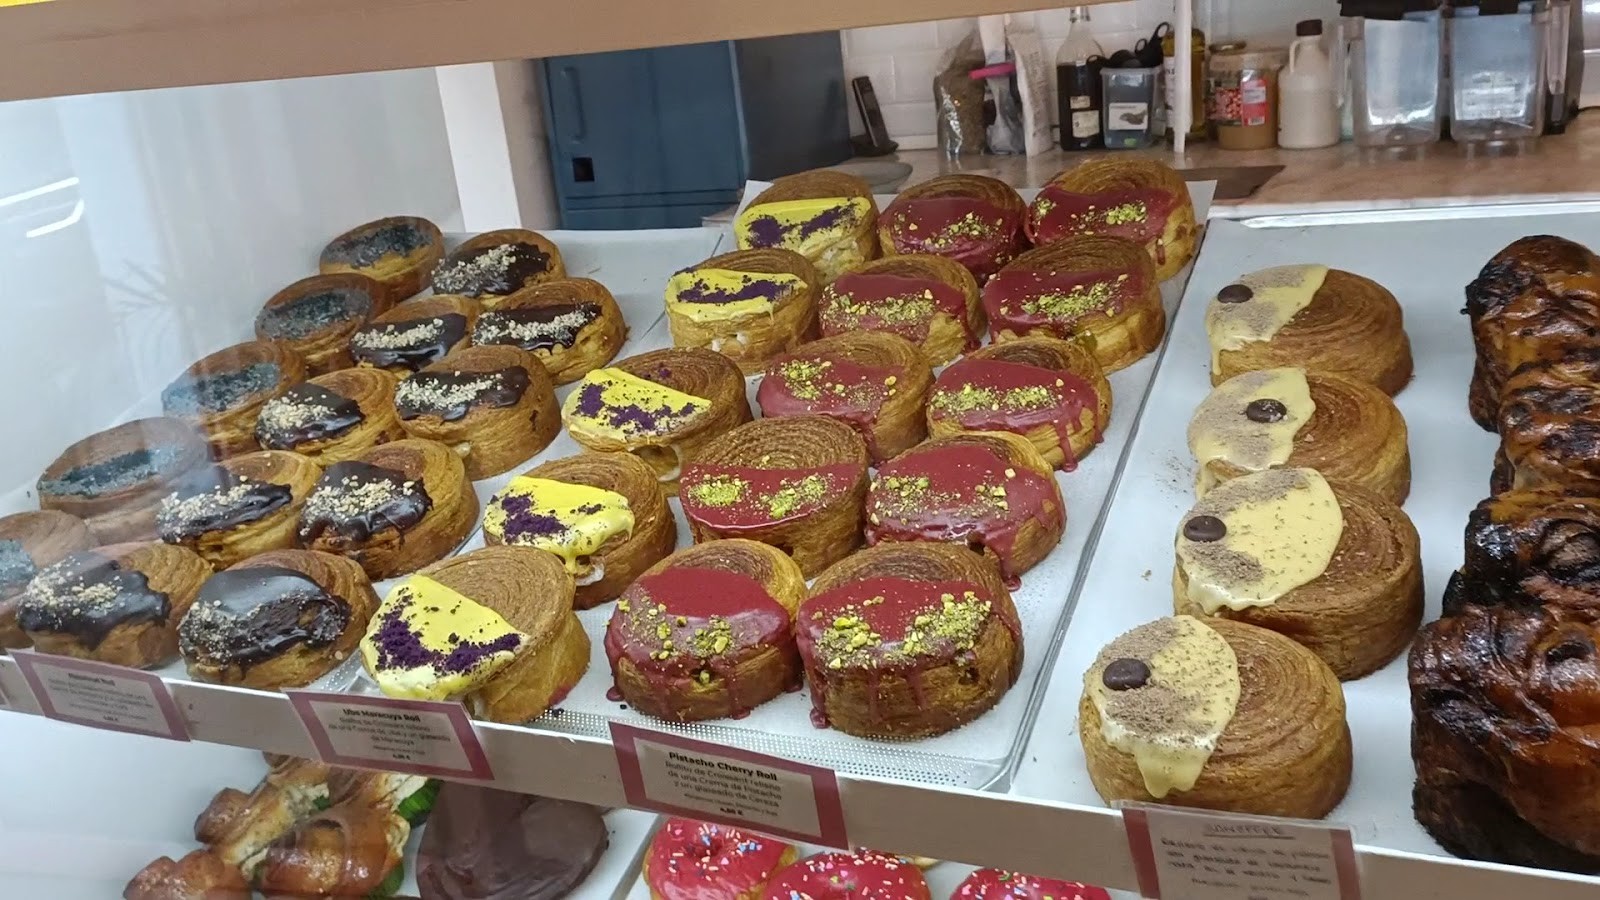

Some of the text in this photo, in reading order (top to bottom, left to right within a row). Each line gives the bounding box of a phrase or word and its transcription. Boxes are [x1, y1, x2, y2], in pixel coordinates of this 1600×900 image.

[403, 713, 421, 722] Roll
[669, 751, 777, 781] Pistacho Cherry Roll
[668, 769, 679, 778] de
[694, 768, 705, 776] de
